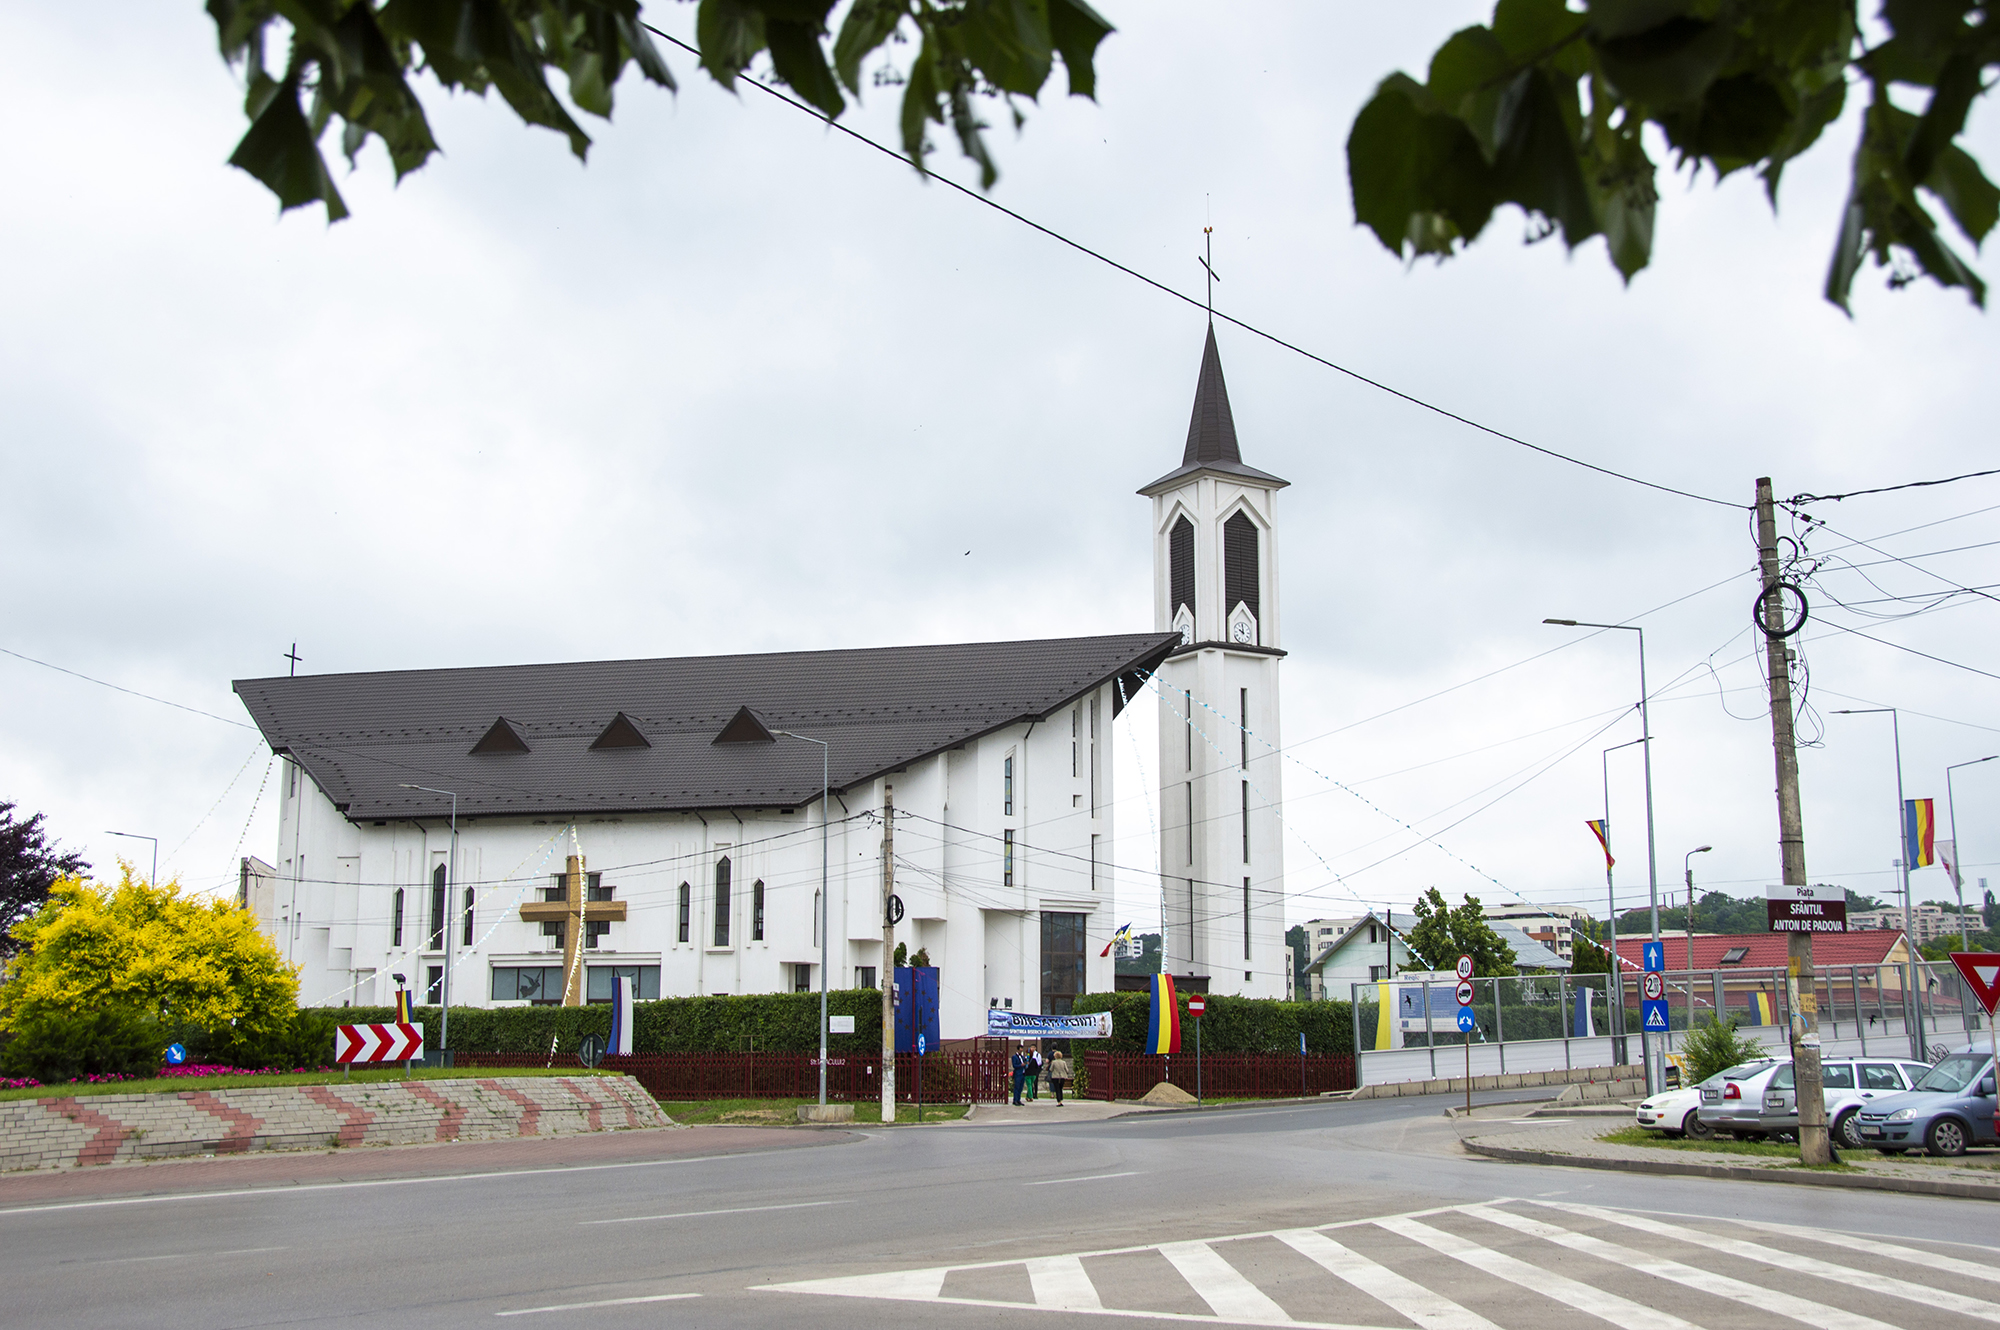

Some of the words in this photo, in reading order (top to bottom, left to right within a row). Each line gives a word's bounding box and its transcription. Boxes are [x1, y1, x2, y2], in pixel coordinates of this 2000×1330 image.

[1797, 887, 1814, 900] Piața
[1790, 900, 1824, 915] SFÂNTUL
[1773, 919, 1800, 931] ANTON
[1801, 920, 1811, 931] DE
[1813, 920, 1843, 931] PADOVA
[1460, 961, 1469, 974] 40
[1012, 1016, 1040, 1026] BINE
[1061, 1016, 1096, 1026] VENIT!
